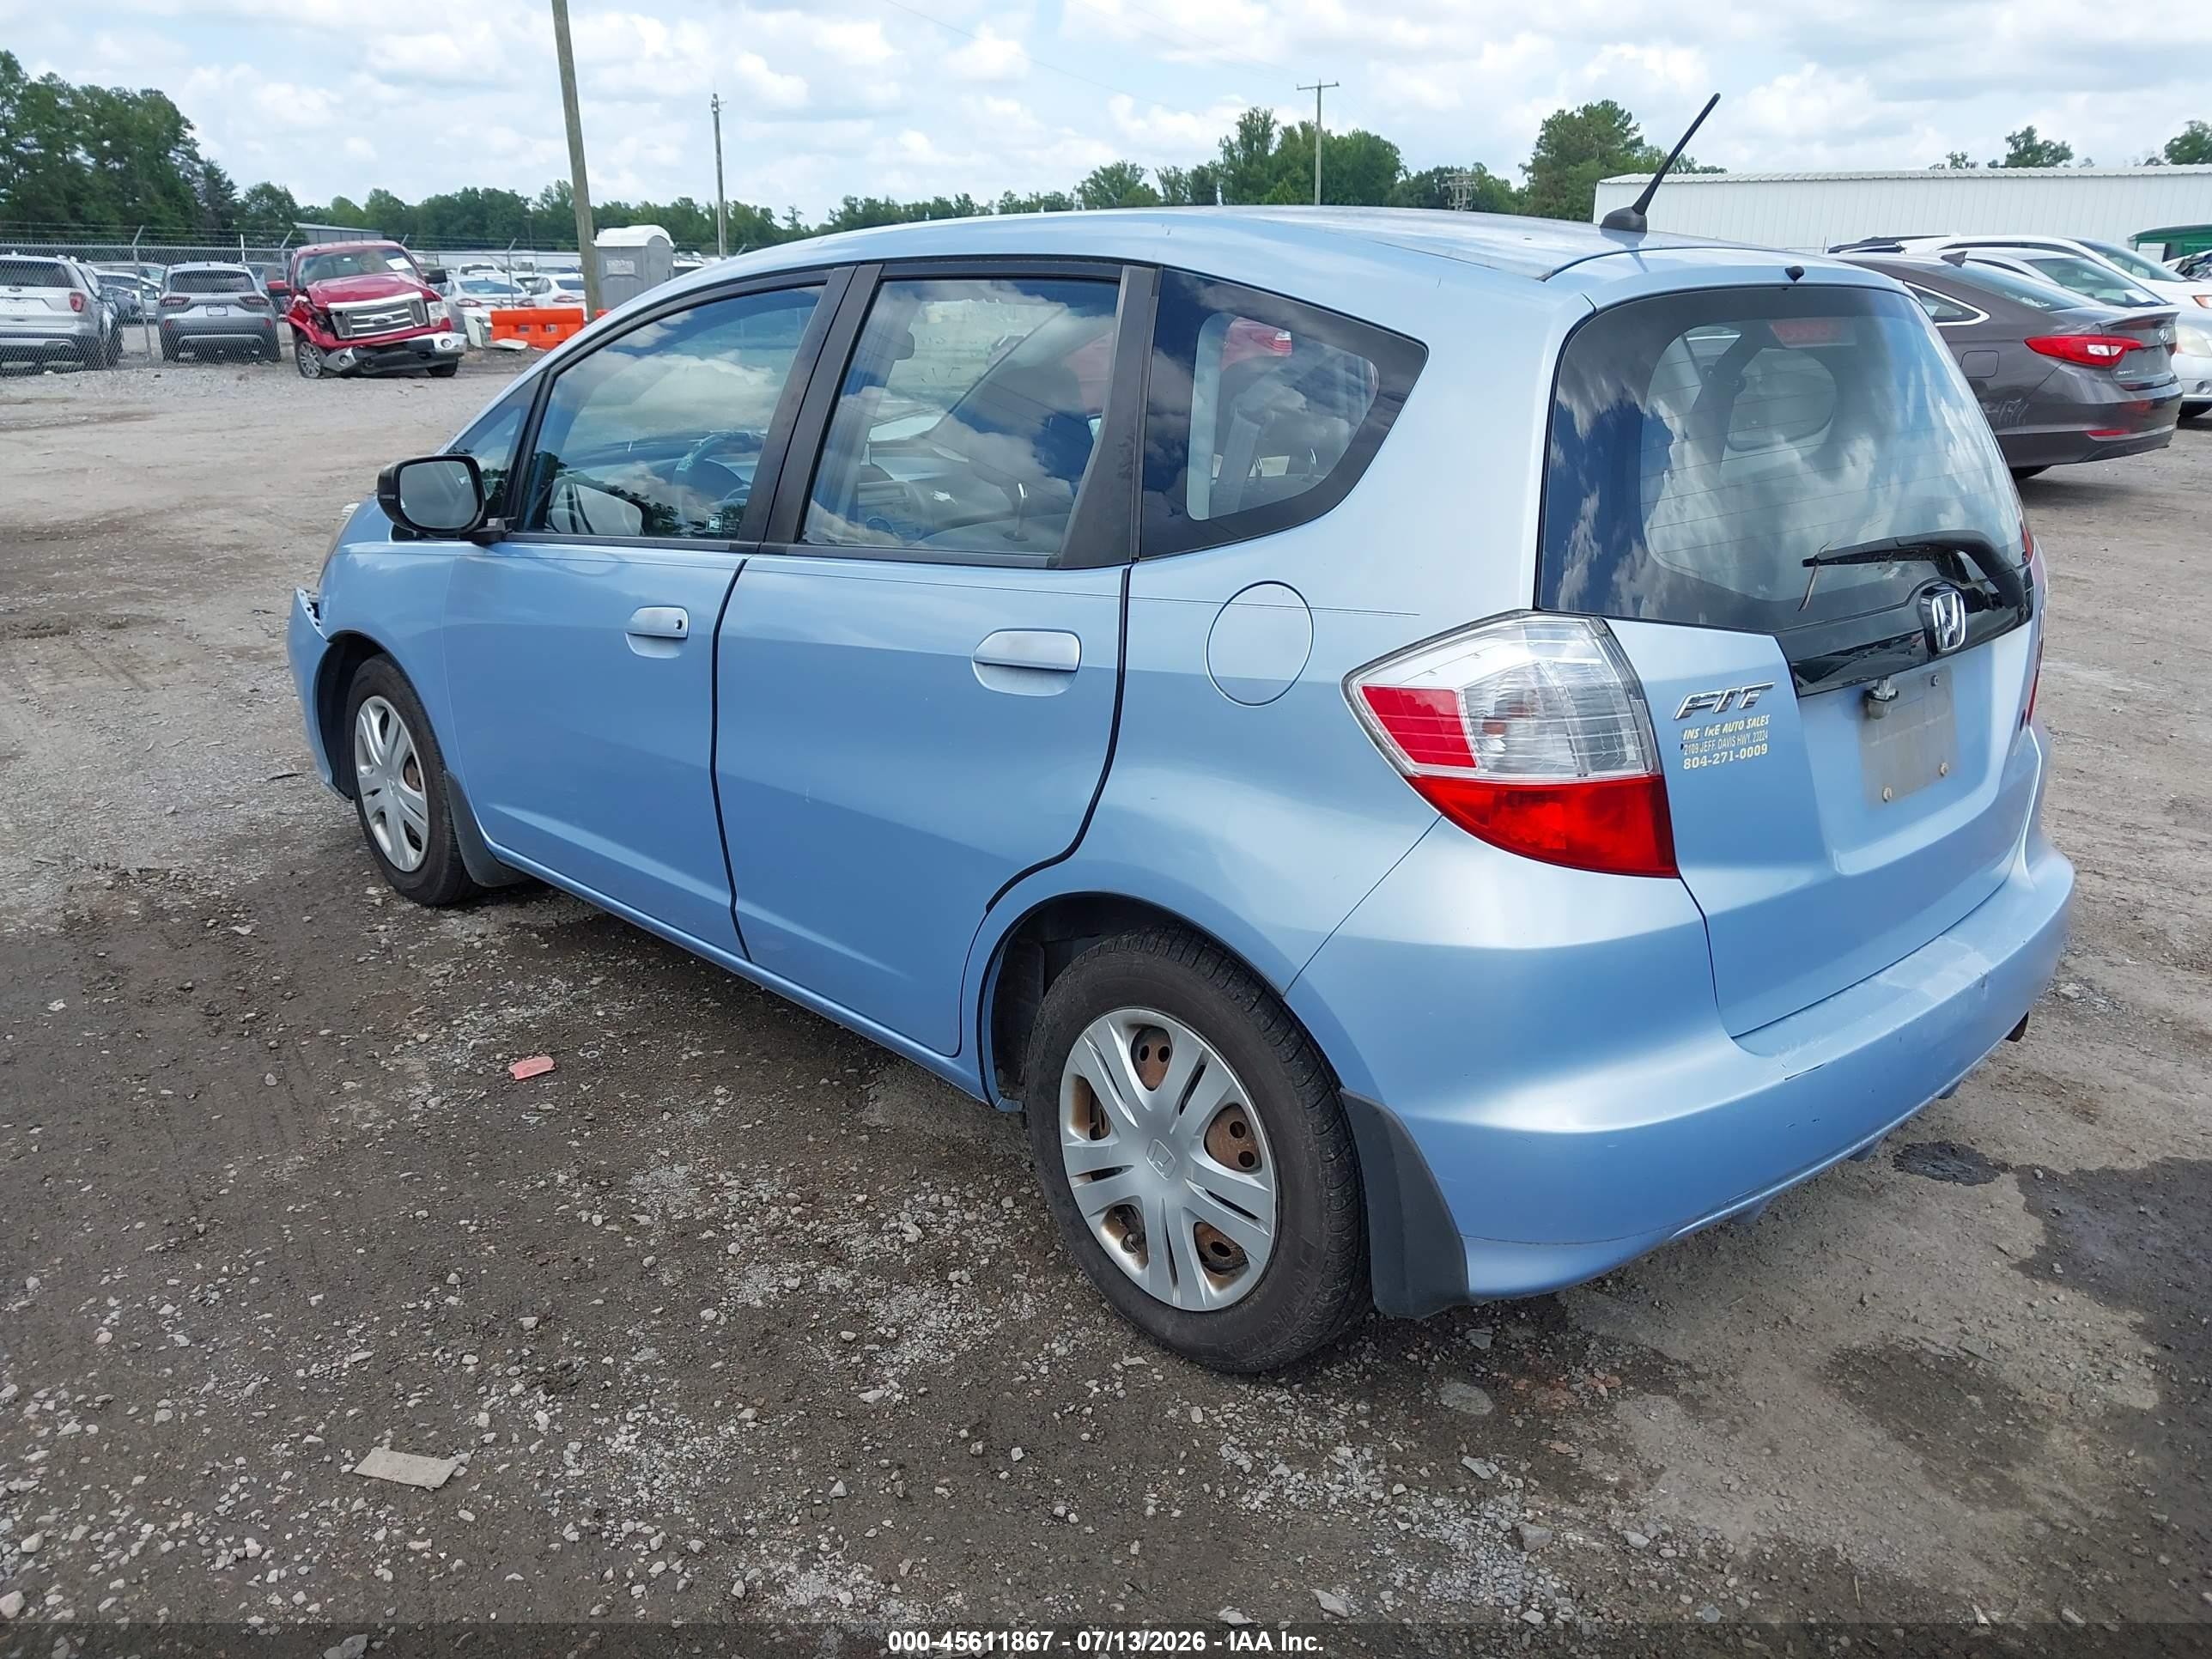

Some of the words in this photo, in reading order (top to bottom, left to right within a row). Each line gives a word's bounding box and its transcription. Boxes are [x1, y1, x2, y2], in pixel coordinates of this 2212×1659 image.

[1674, 681, 1776, 720] FIT
[1723, 720, 1745, 735] AUTO
[1747, 714, 1770, 730] SALES
[1683, 744, 1698, 756] 2109
[1718, 735, 1736, 750] DAVIS
[1683, 743, 1768, 770] 804-271-0009
